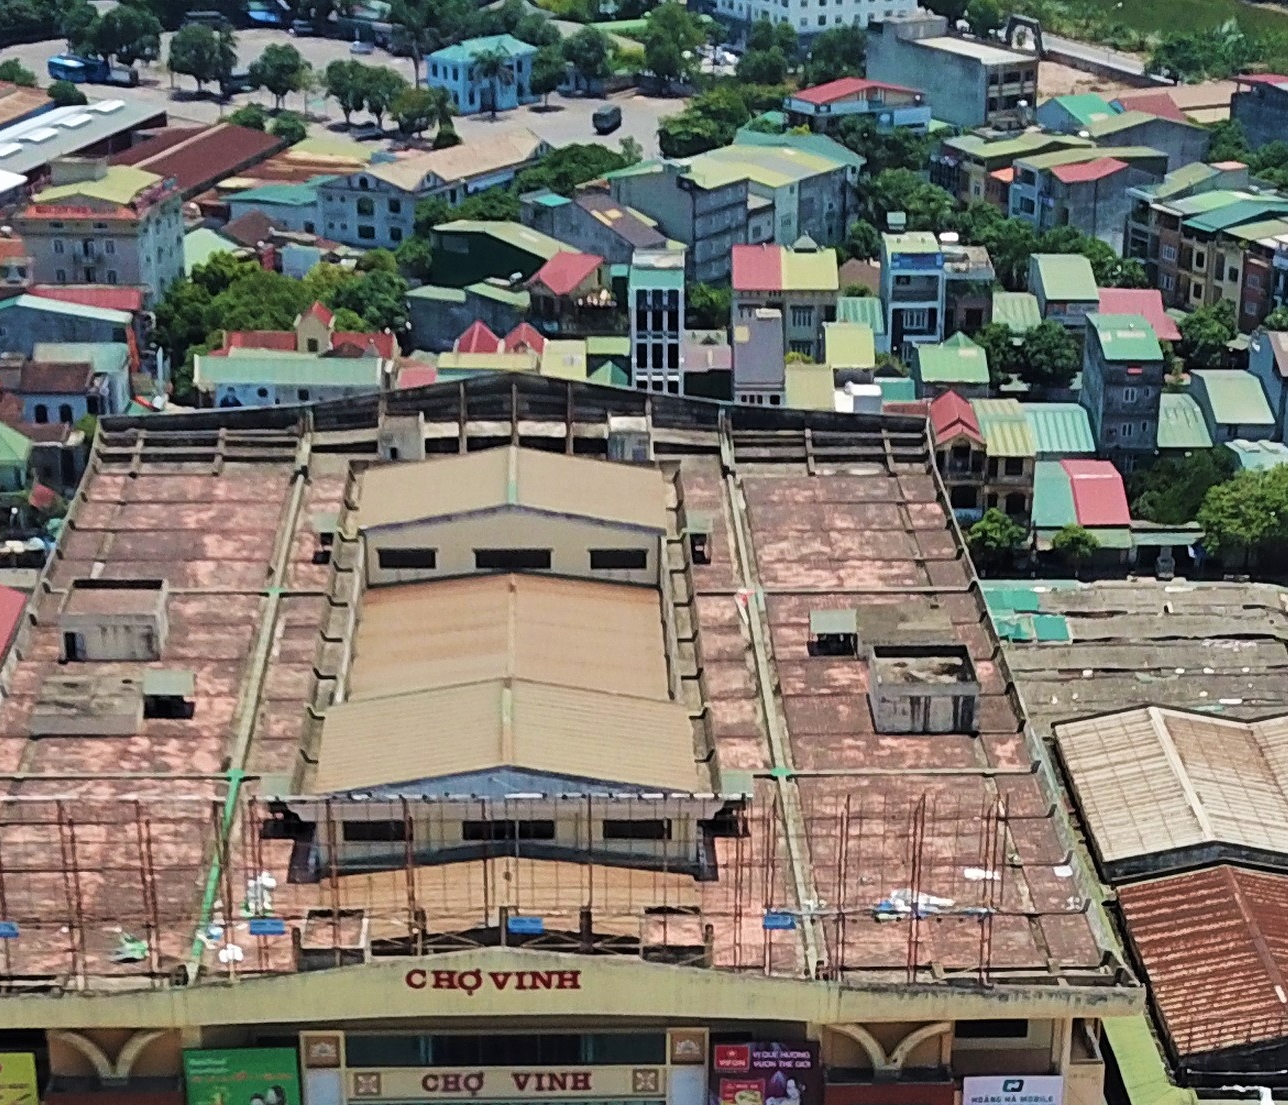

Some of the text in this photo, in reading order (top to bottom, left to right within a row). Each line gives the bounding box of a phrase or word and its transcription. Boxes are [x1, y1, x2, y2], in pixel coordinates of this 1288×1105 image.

[405, 967, 581, 996] CHỢ VINH
[422, 1071, 592, 1096] CHỢ VINH
